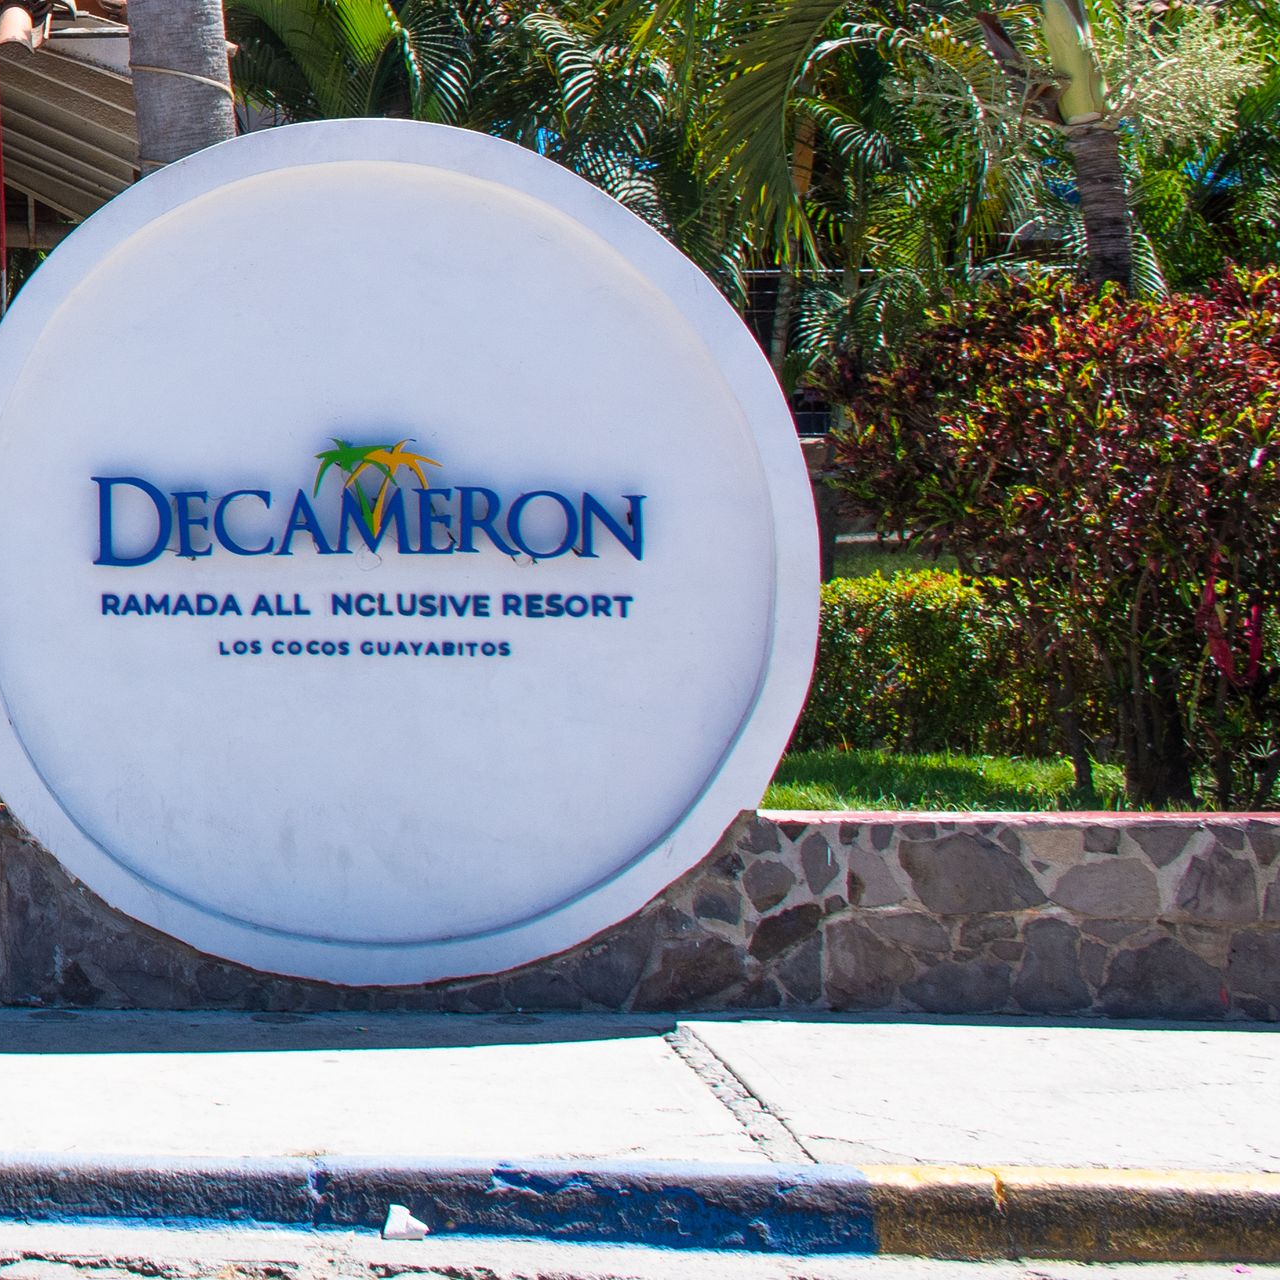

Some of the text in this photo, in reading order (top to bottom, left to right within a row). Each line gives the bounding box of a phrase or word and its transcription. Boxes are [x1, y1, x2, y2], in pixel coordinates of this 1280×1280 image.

[91, 476, 647, 567] DECAMERON
[101, 594, 241, 616] RAMADA
[251, 594, 311, 616] ALL
[502, 595, 634, 618] RESORT
[219, 640, 512, 657] LOS COCOS GUAYABITOS
